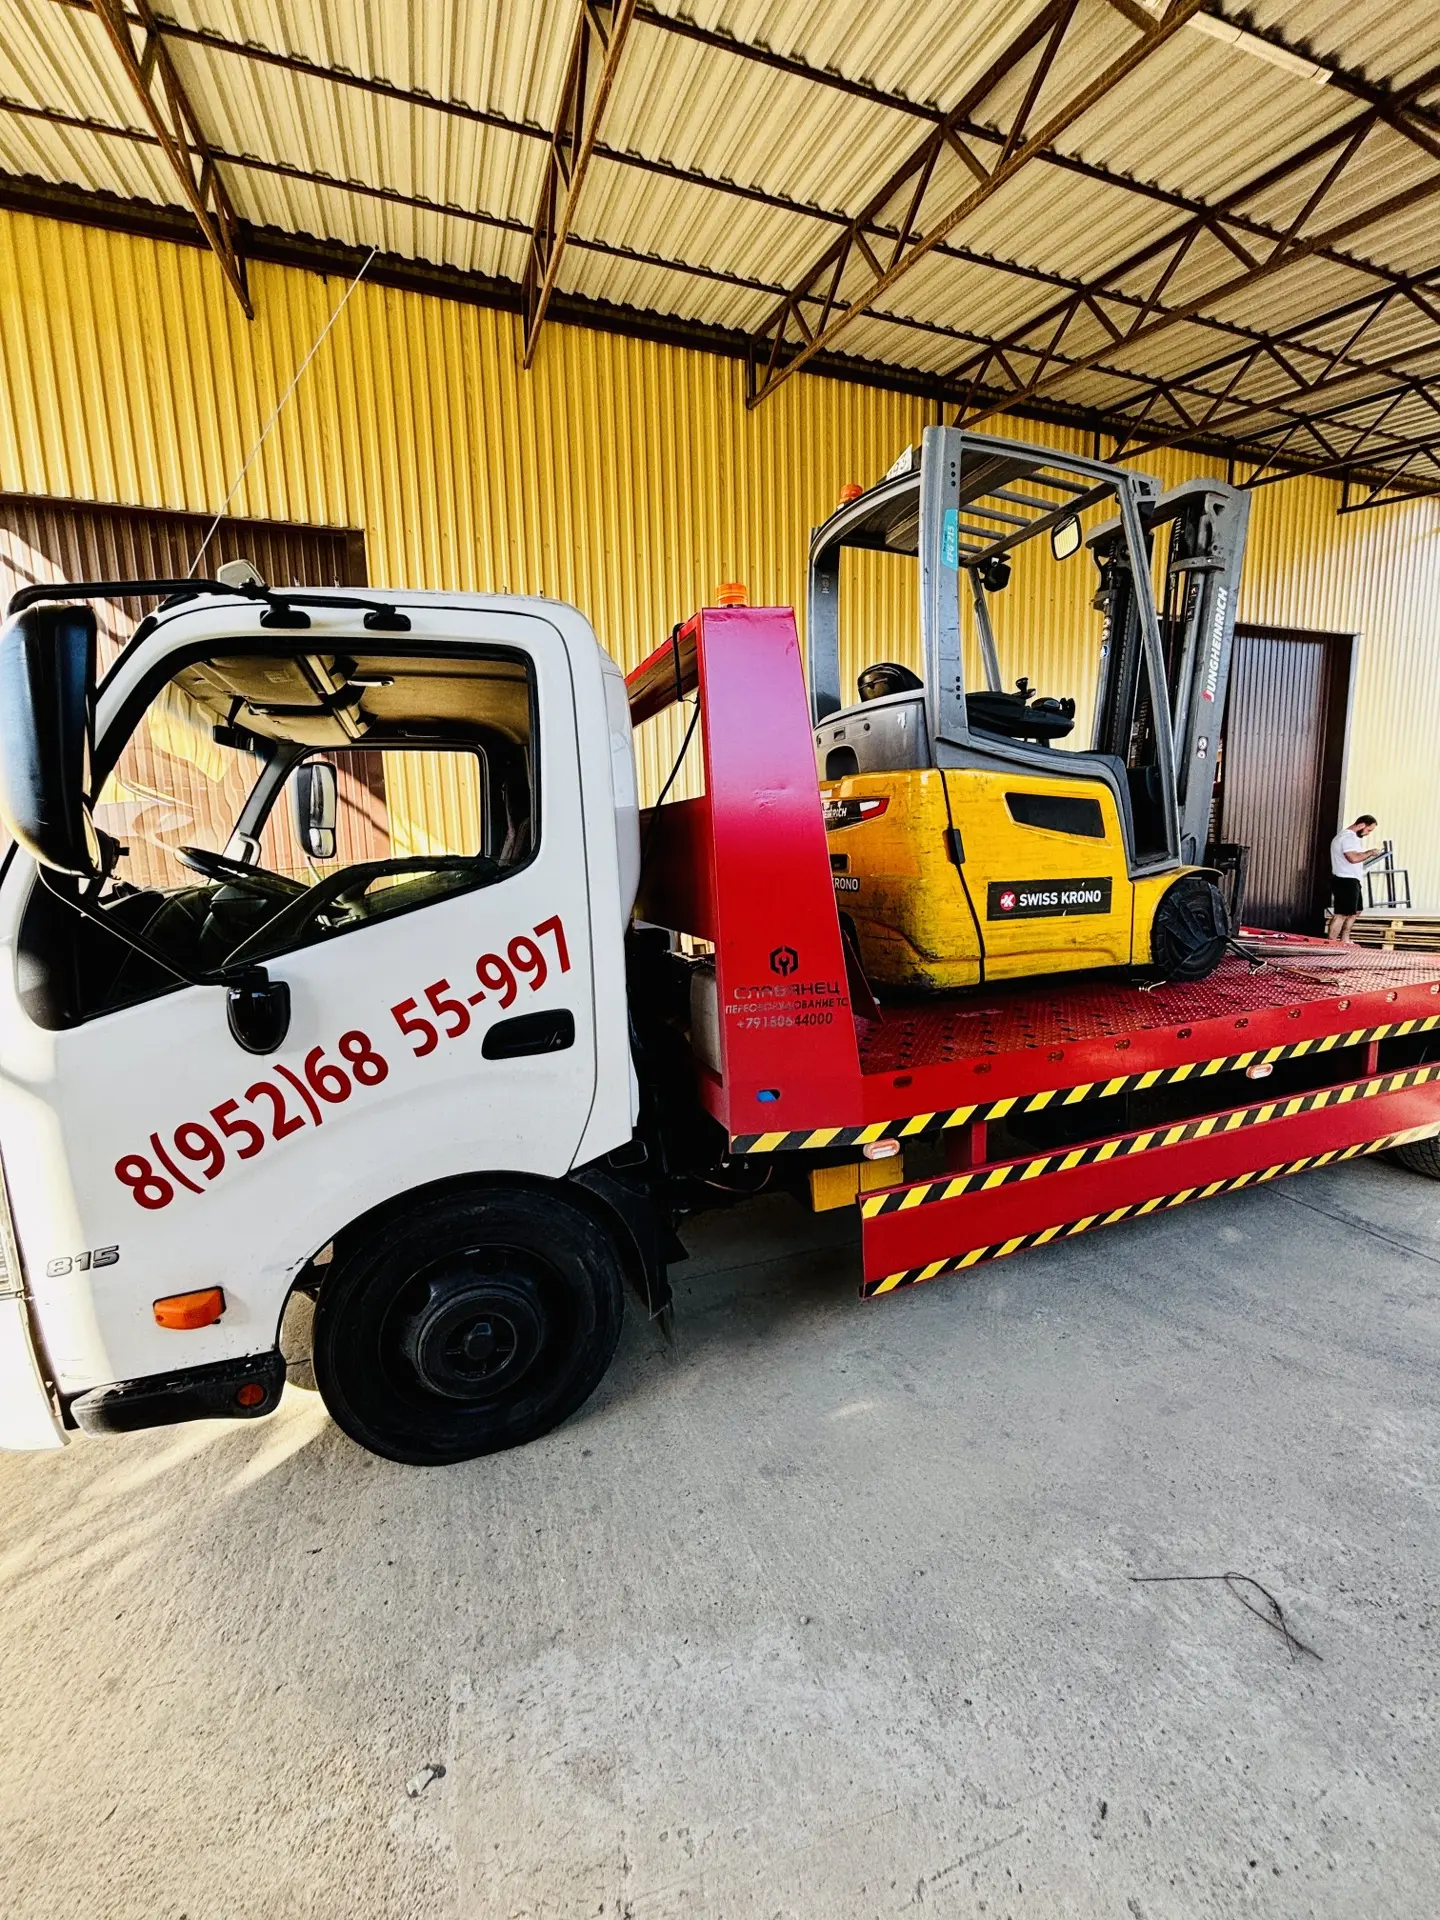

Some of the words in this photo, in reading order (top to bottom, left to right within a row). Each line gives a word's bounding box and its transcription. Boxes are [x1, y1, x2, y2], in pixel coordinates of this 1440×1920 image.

[1201, 586, 1228, 703] JUNGHEINRICH
[1019, 891, 1059, 907] SWISS
[1061, 889, 1102, 905] KRONO
[114, 1030, 389, 1210] 8(952)68
[391, 915, 572, 1056] 55-997
[46, 1244, 120, 1278] 815
